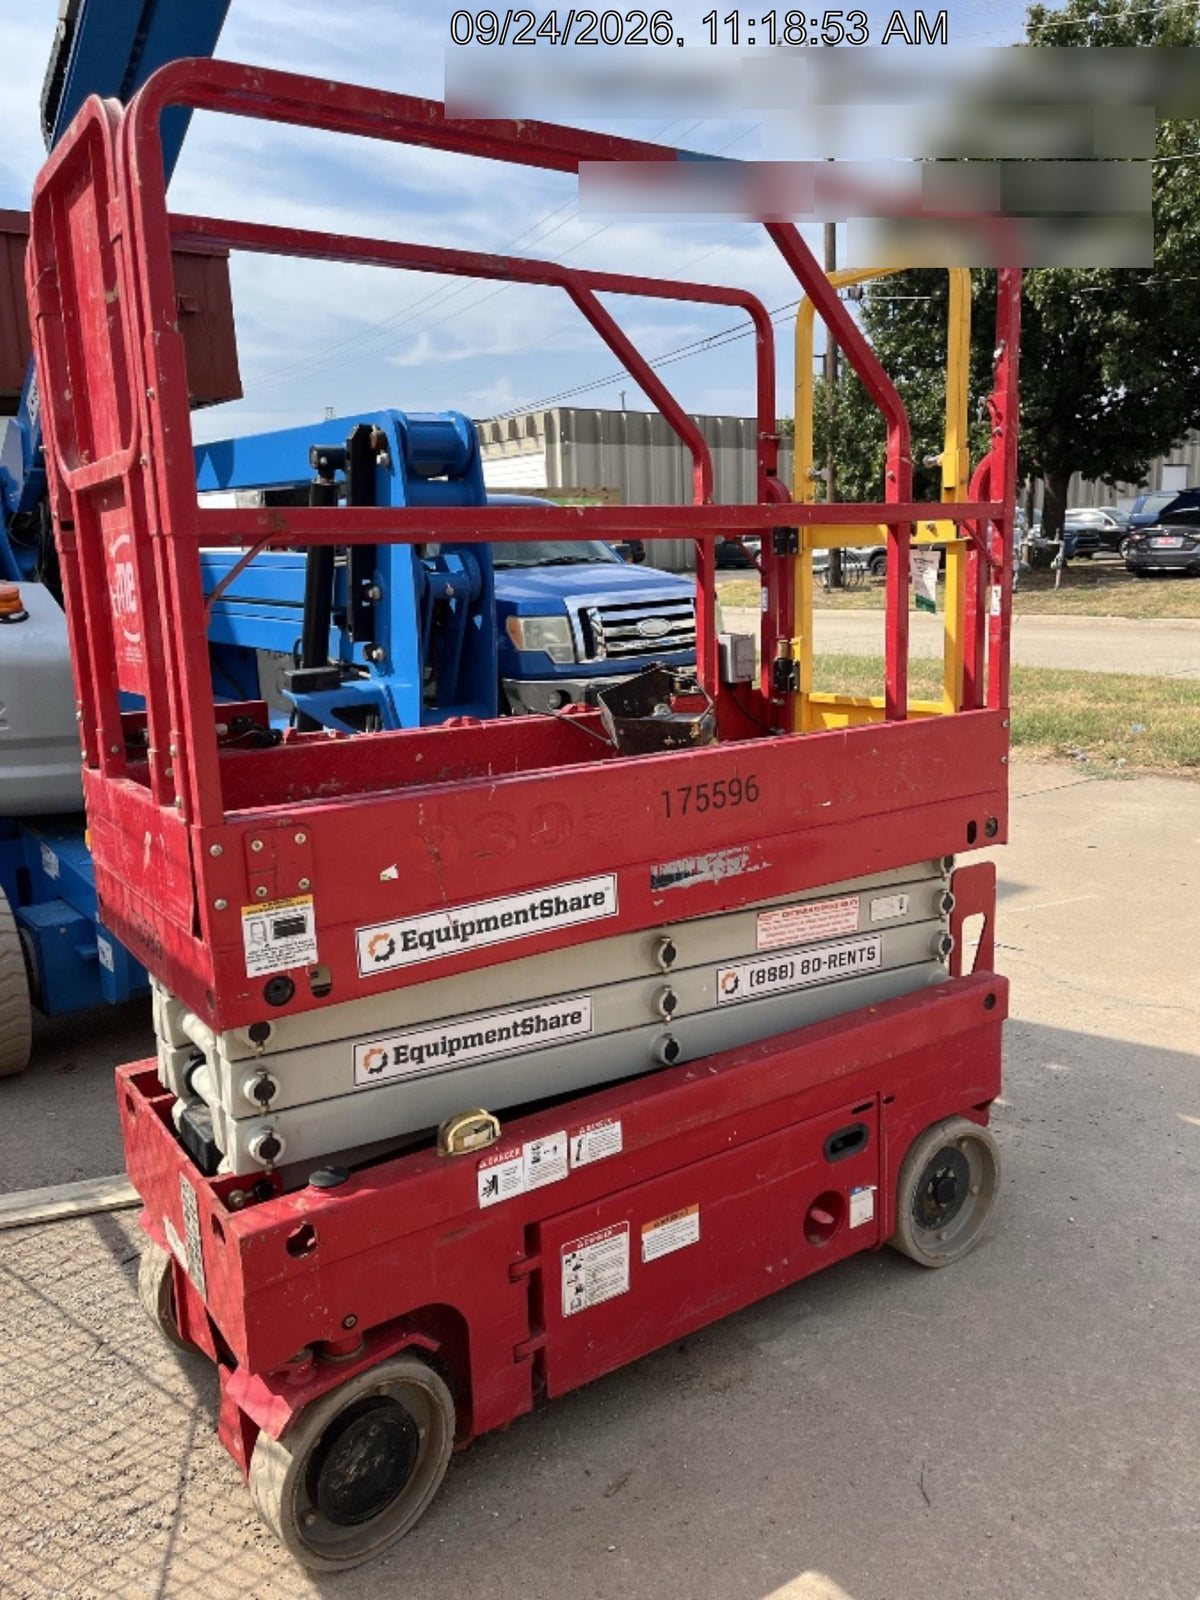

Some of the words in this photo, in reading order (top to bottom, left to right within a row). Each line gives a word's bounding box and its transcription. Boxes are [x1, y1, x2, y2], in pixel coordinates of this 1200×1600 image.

[661, 775, 759, 818] 175596
[401, 888, 606, 952] EquipmentShare
[750, 961, 794, 987] (888)
[393, 1009, 582, 1065] EquipmentShare
